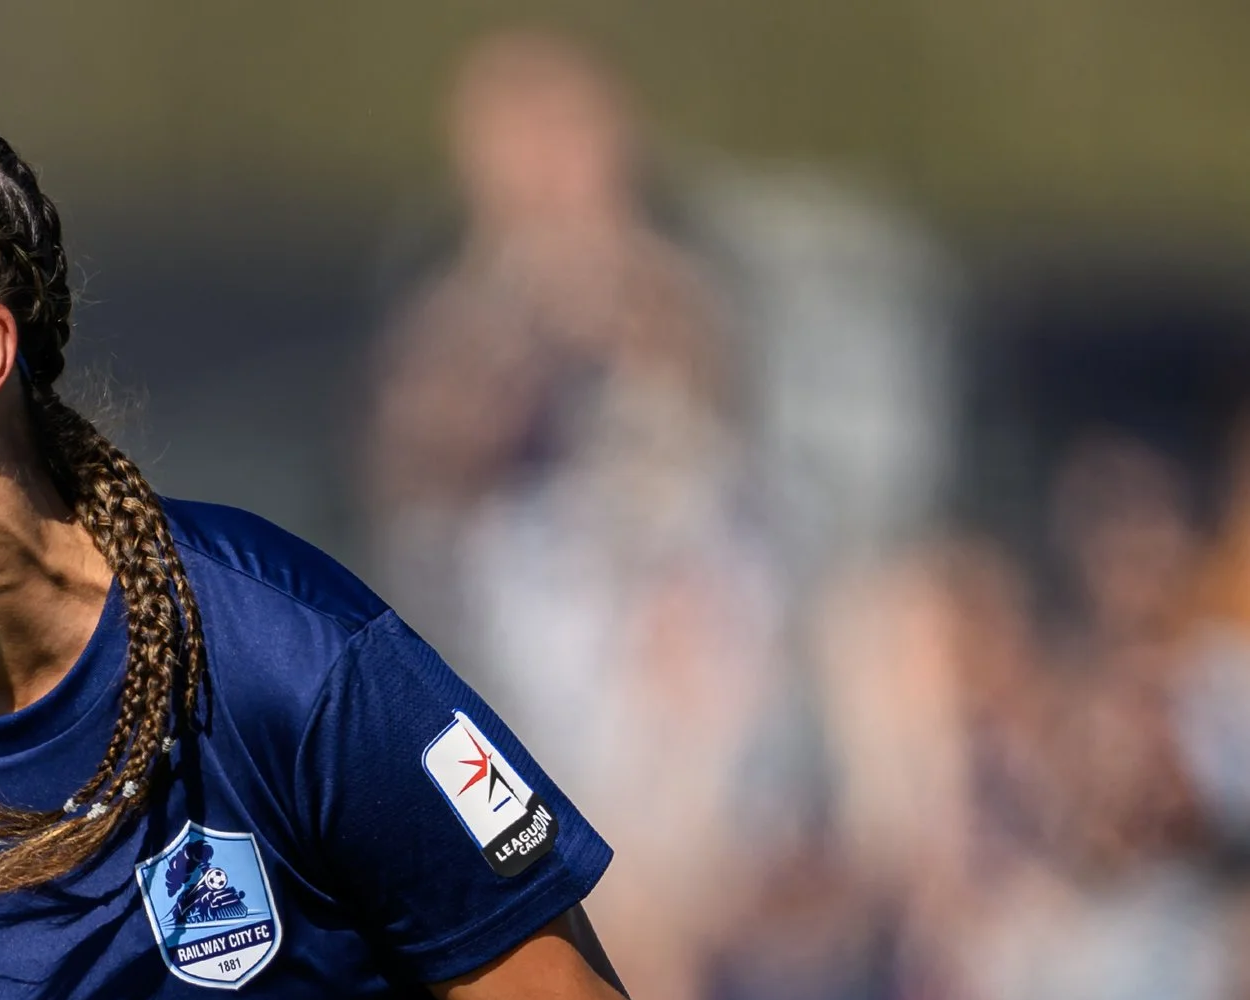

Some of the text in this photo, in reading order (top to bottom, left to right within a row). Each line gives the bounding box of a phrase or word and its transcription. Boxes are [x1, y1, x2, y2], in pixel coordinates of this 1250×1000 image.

[177, 925, 270, 962] RAILWAY CITY FC
[218, 957, 242, 974] 1881
